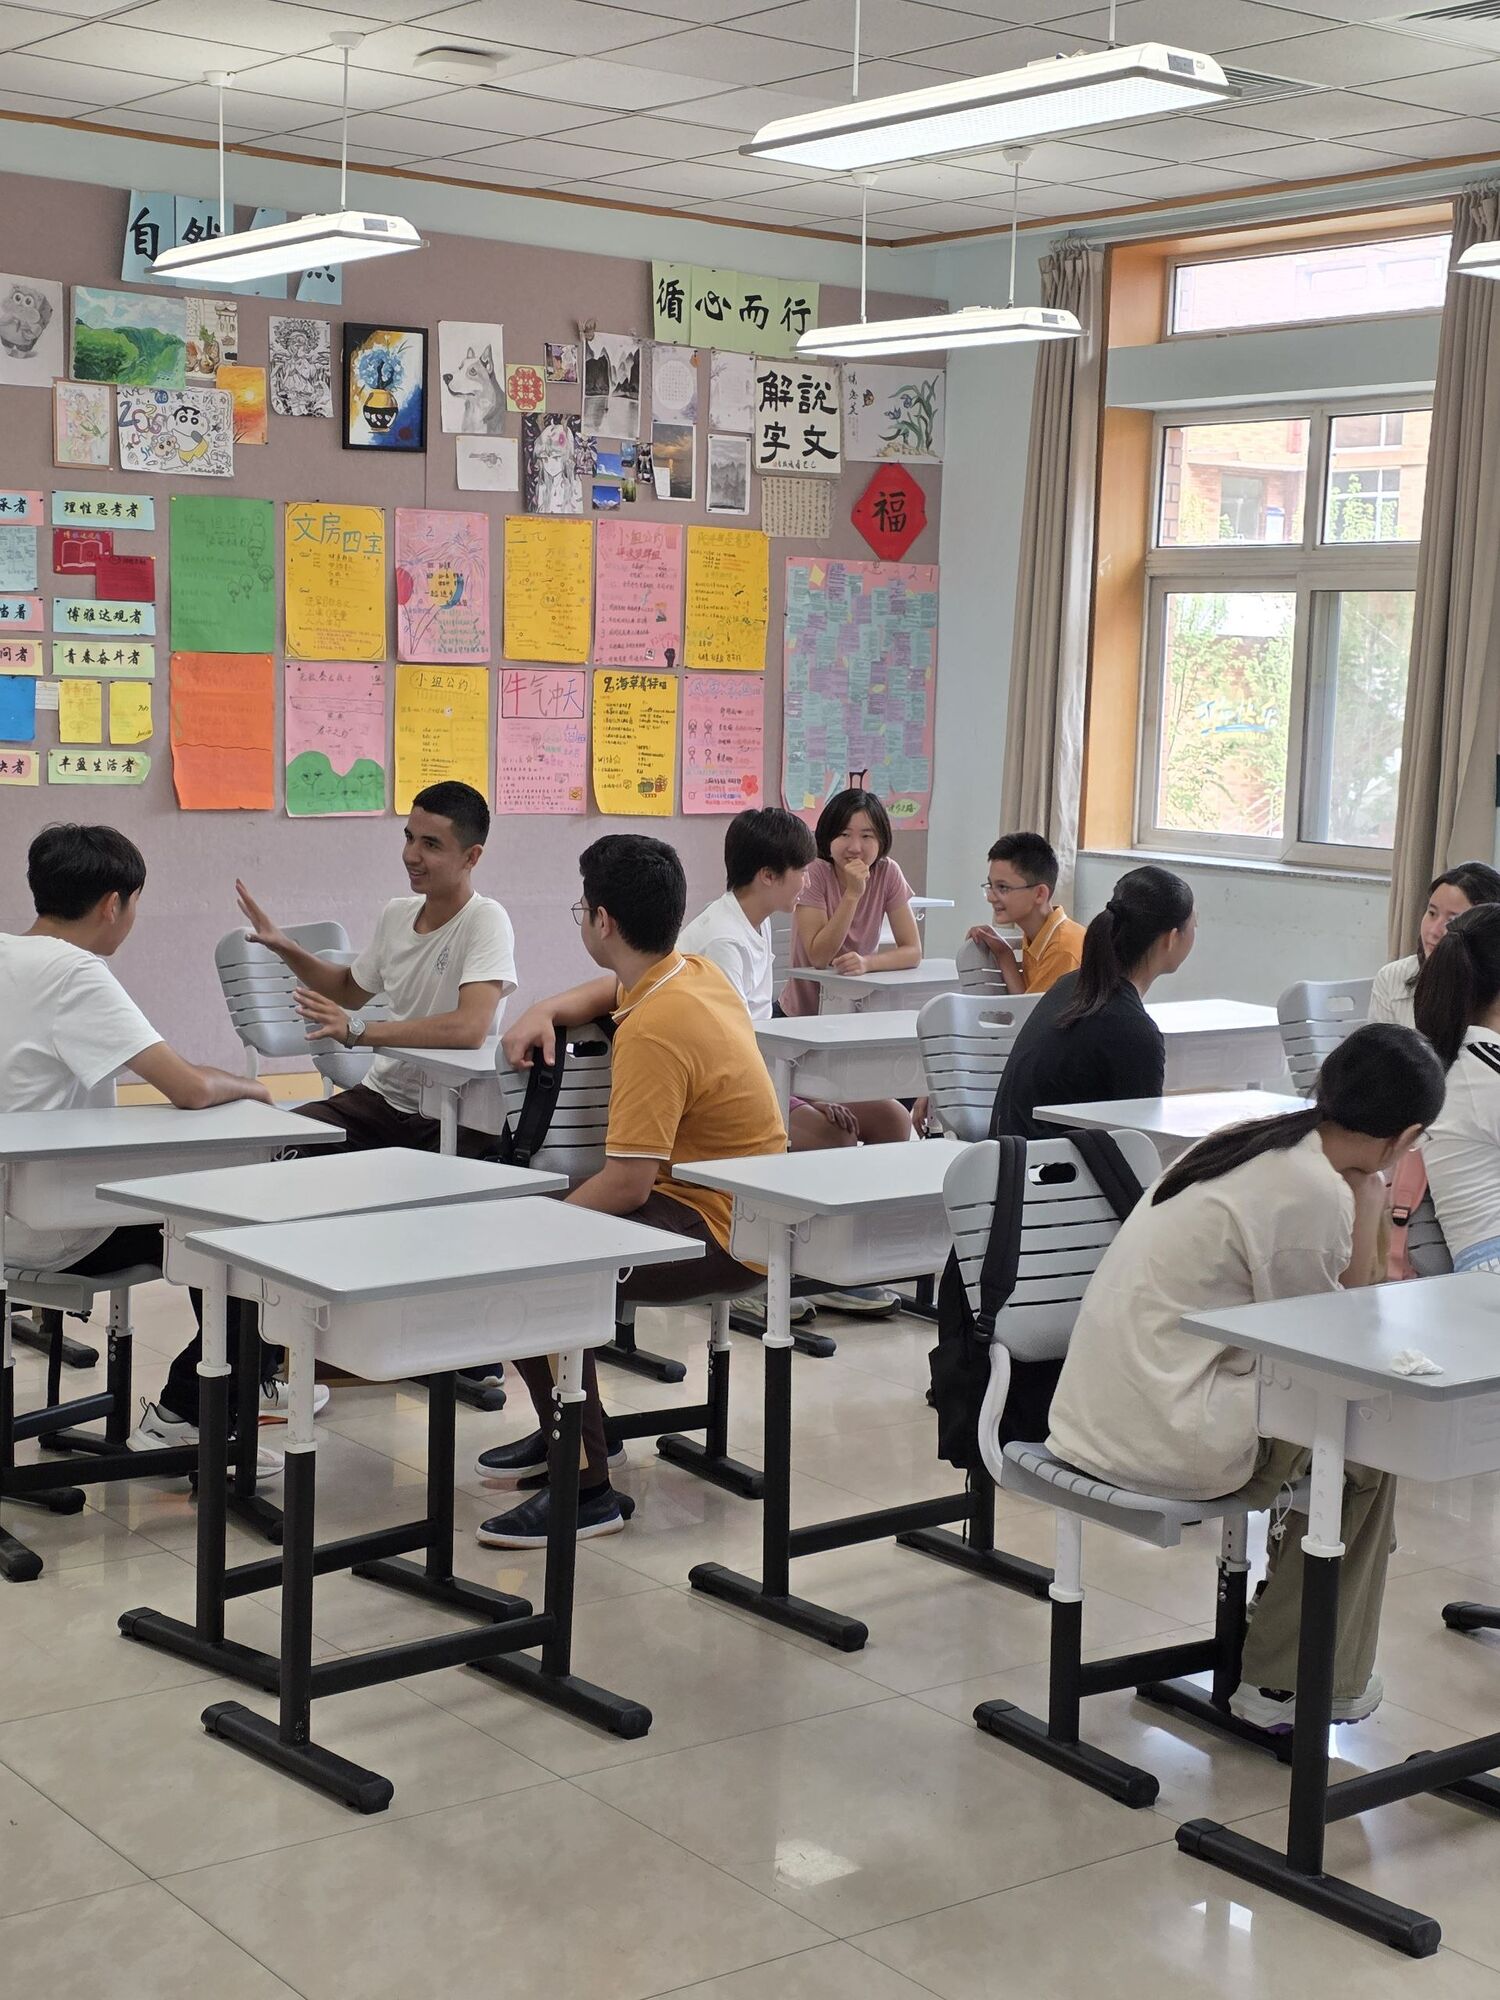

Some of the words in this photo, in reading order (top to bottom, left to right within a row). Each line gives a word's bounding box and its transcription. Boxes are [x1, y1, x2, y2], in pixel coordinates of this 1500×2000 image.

[655, 276, 812, 335] 循心而行
[63, 501, 139, 518] 理性思考者
[872, 491, 907, 534] 福
[291, 512, 384, 555] 文房四宝
[66, 606, 142, 624] 博雅达观者
[64, 648, 141, 665] 青春奋斗者
[415, 672, 470, 692] 小组公约
[503, 671, 584, 717] 牛气冲天
[58, 756, 137, 774] 丰盈生活者
